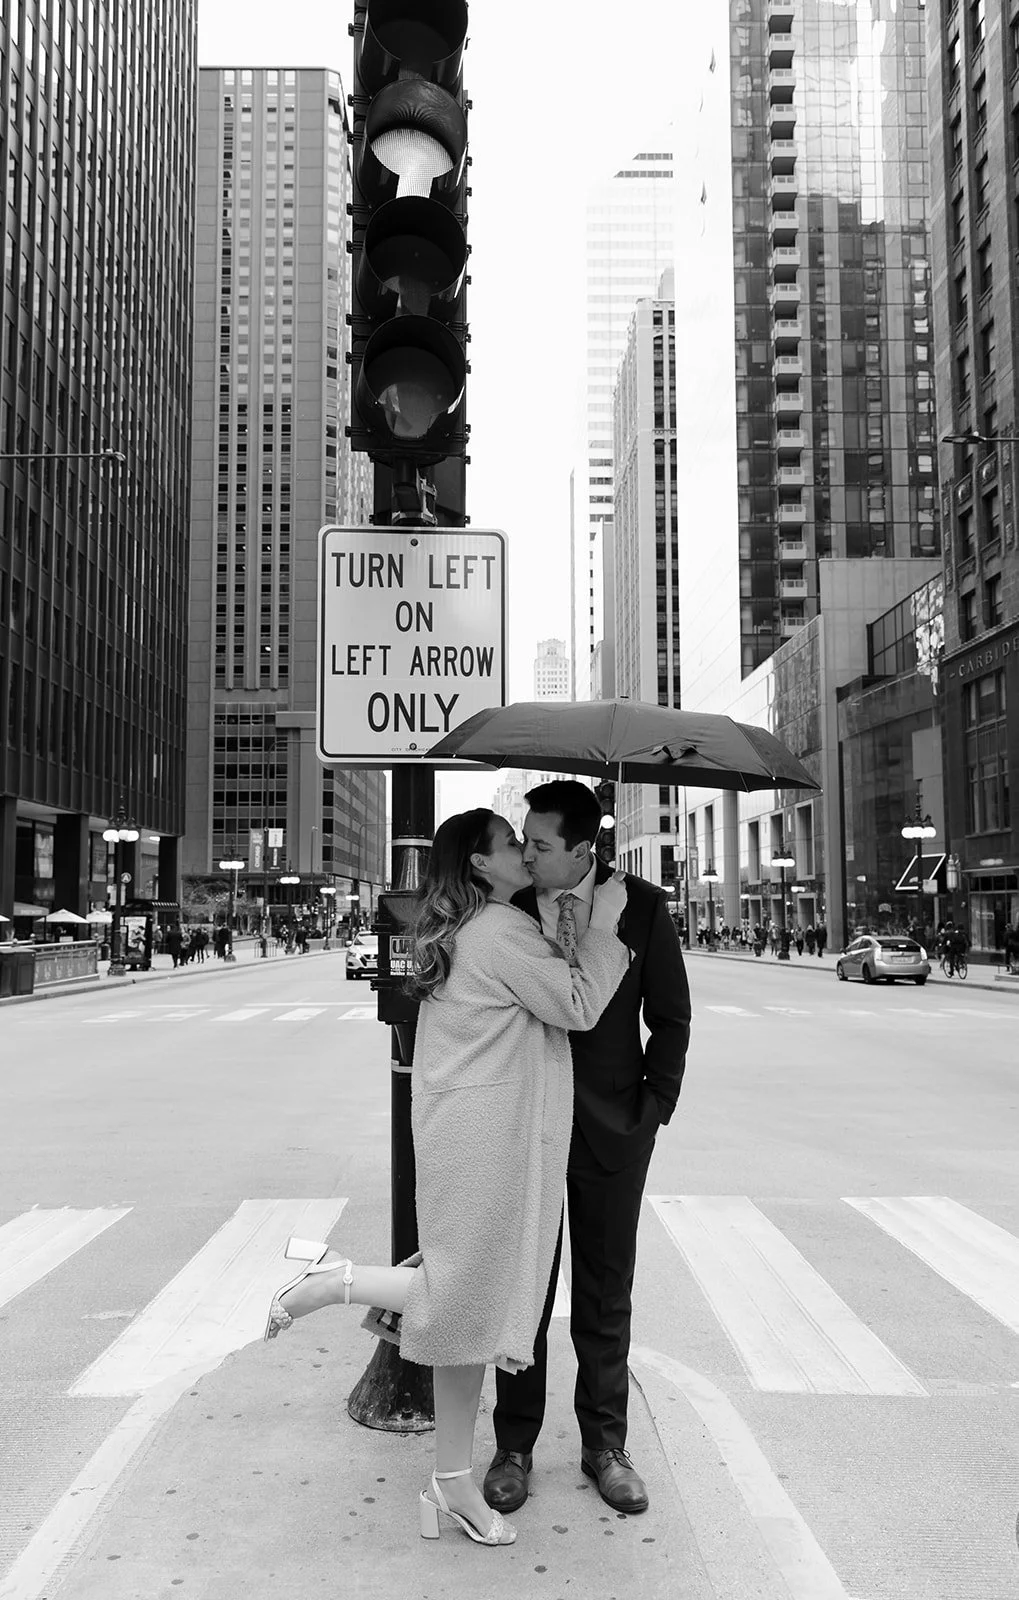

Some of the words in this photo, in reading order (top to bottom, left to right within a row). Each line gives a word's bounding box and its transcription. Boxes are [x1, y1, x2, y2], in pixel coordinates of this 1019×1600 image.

[332, 553, 403, 588] TURN
[429, 555, 495, 589] LEFT
[396, 601, 432, 632] ON
[332, 645, 391, 675] LEFT
[410, 646, 493, 677] ARROW
[368, 692, 460, 732] ONLY
